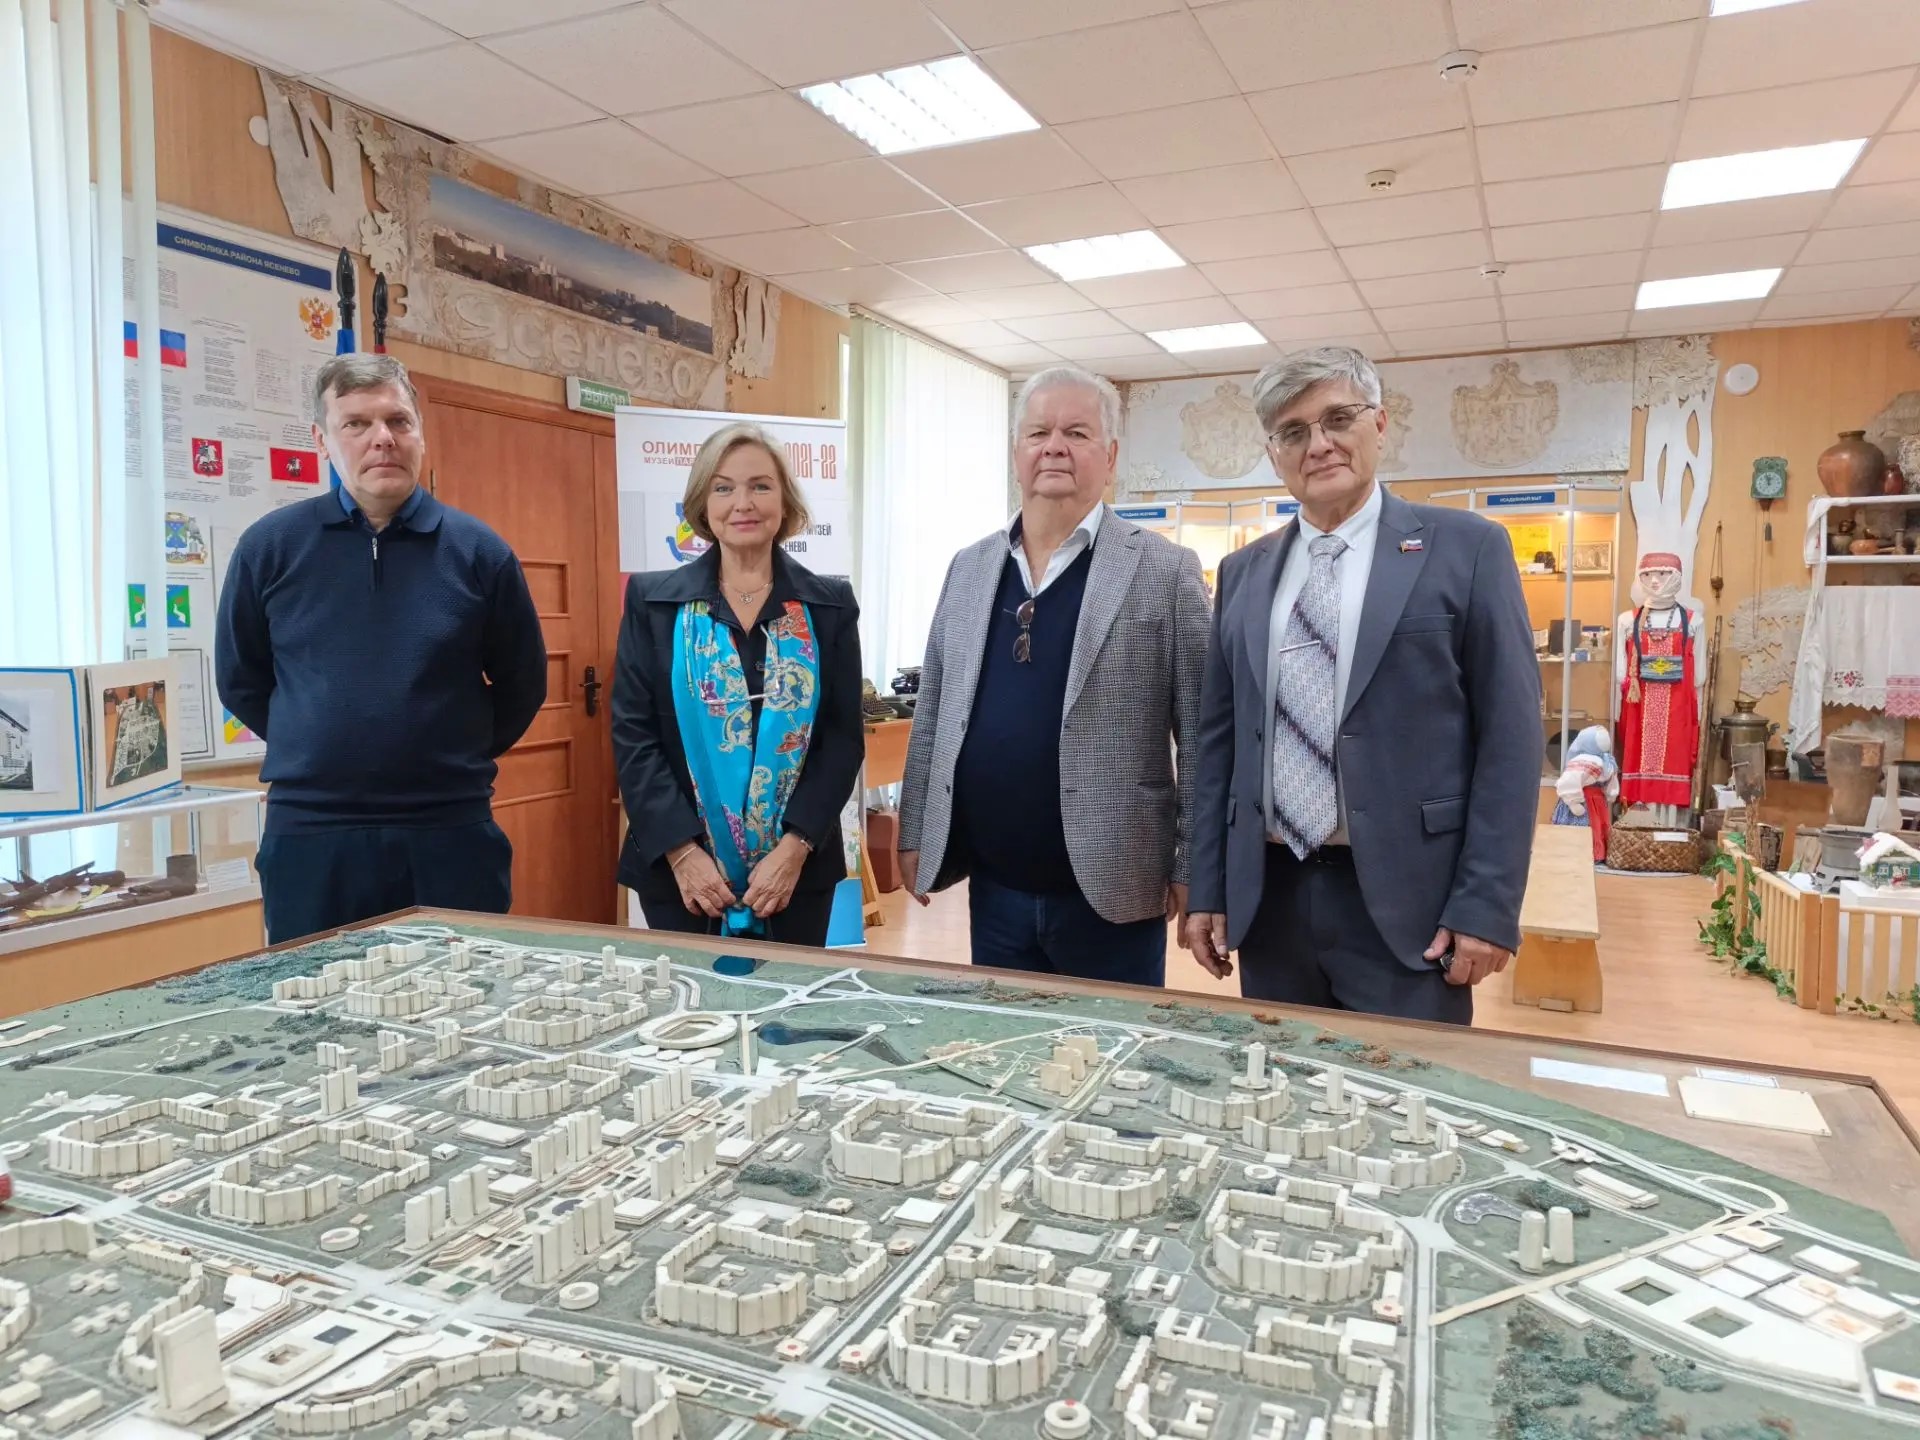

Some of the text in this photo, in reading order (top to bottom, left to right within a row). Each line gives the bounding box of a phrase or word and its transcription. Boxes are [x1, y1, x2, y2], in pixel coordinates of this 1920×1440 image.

[174, 235, 300, 276] СИМВОЛИКА РАЙОНА ЯСЕНЕВО
[642, 440, 703, 456] ОЛИМП
